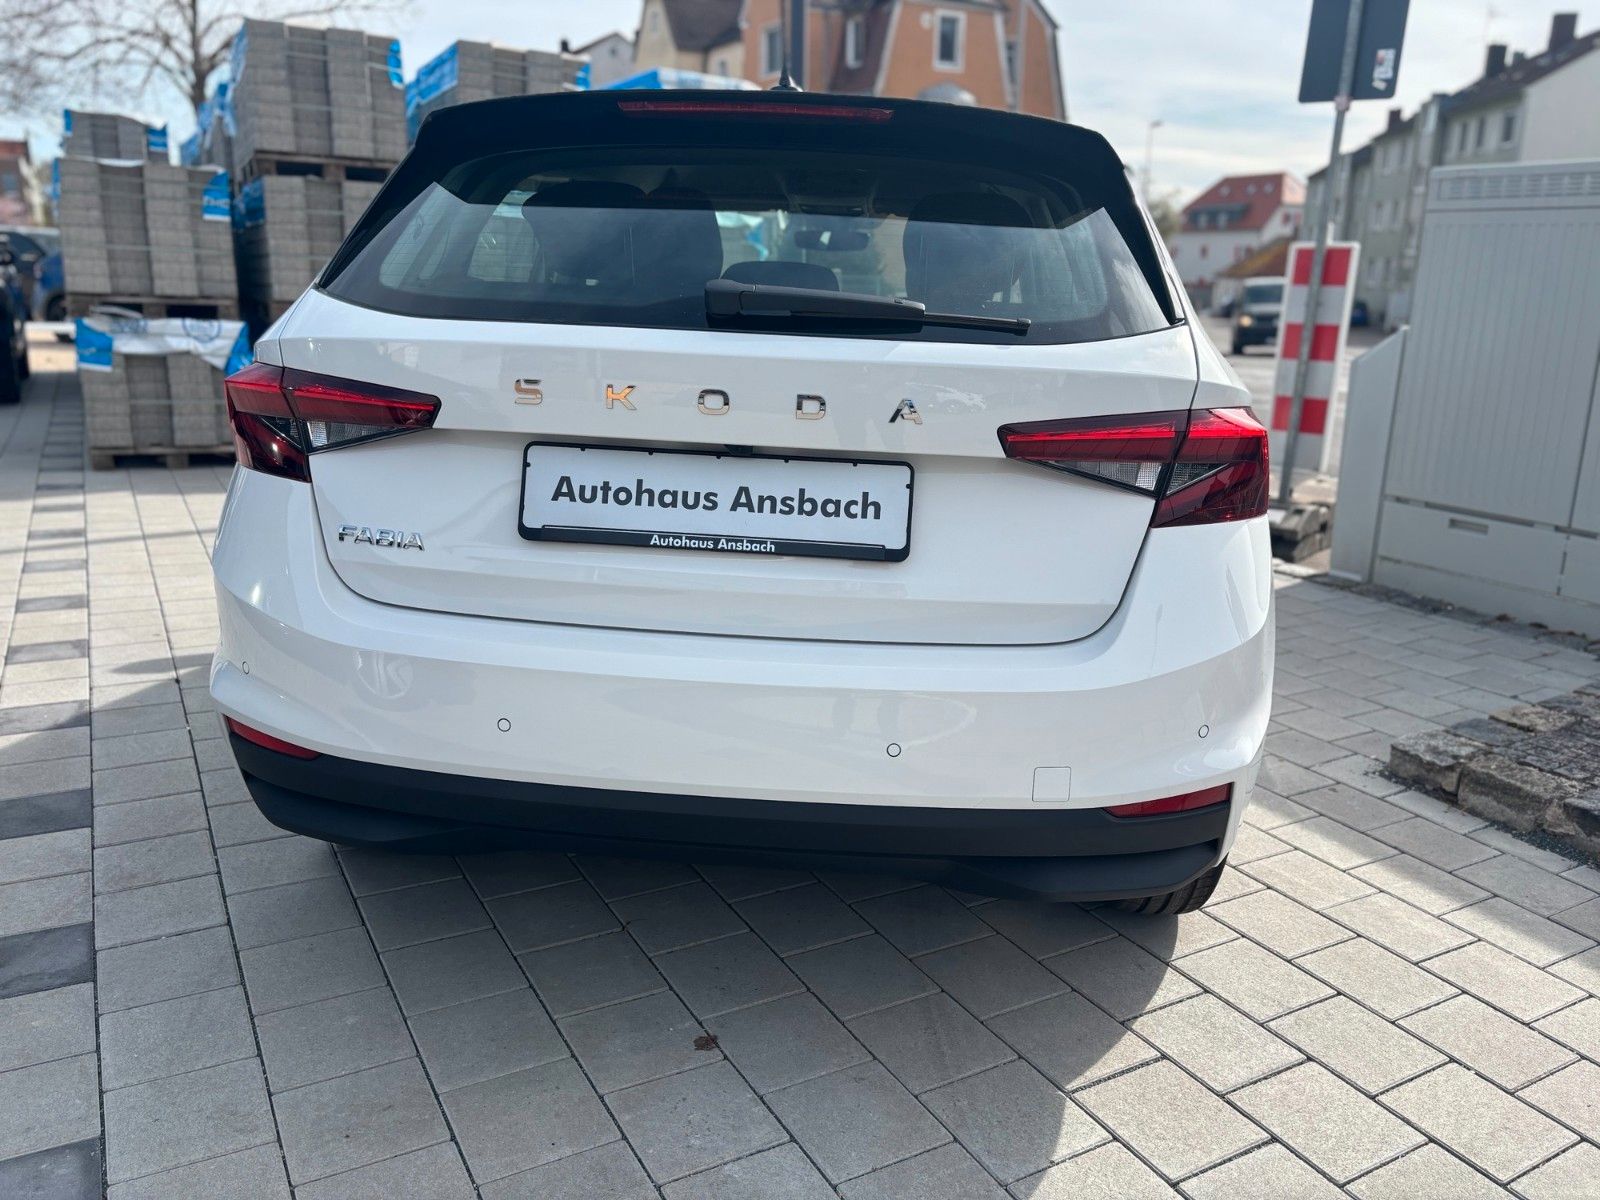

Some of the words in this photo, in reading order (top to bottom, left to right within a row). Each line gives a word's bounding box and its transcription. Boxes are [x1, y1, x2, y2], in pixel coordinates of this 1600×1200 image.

[514, 378, 923, 426] SKODA
[551, 475, 719, 512] Autohaus
[729, 486, 882, 520] Ansbach
[338, 525, 425, 551] FABIA
[650, 534, 714, 550] Autohaus
[717, 538, 776, 553] Ansbach
